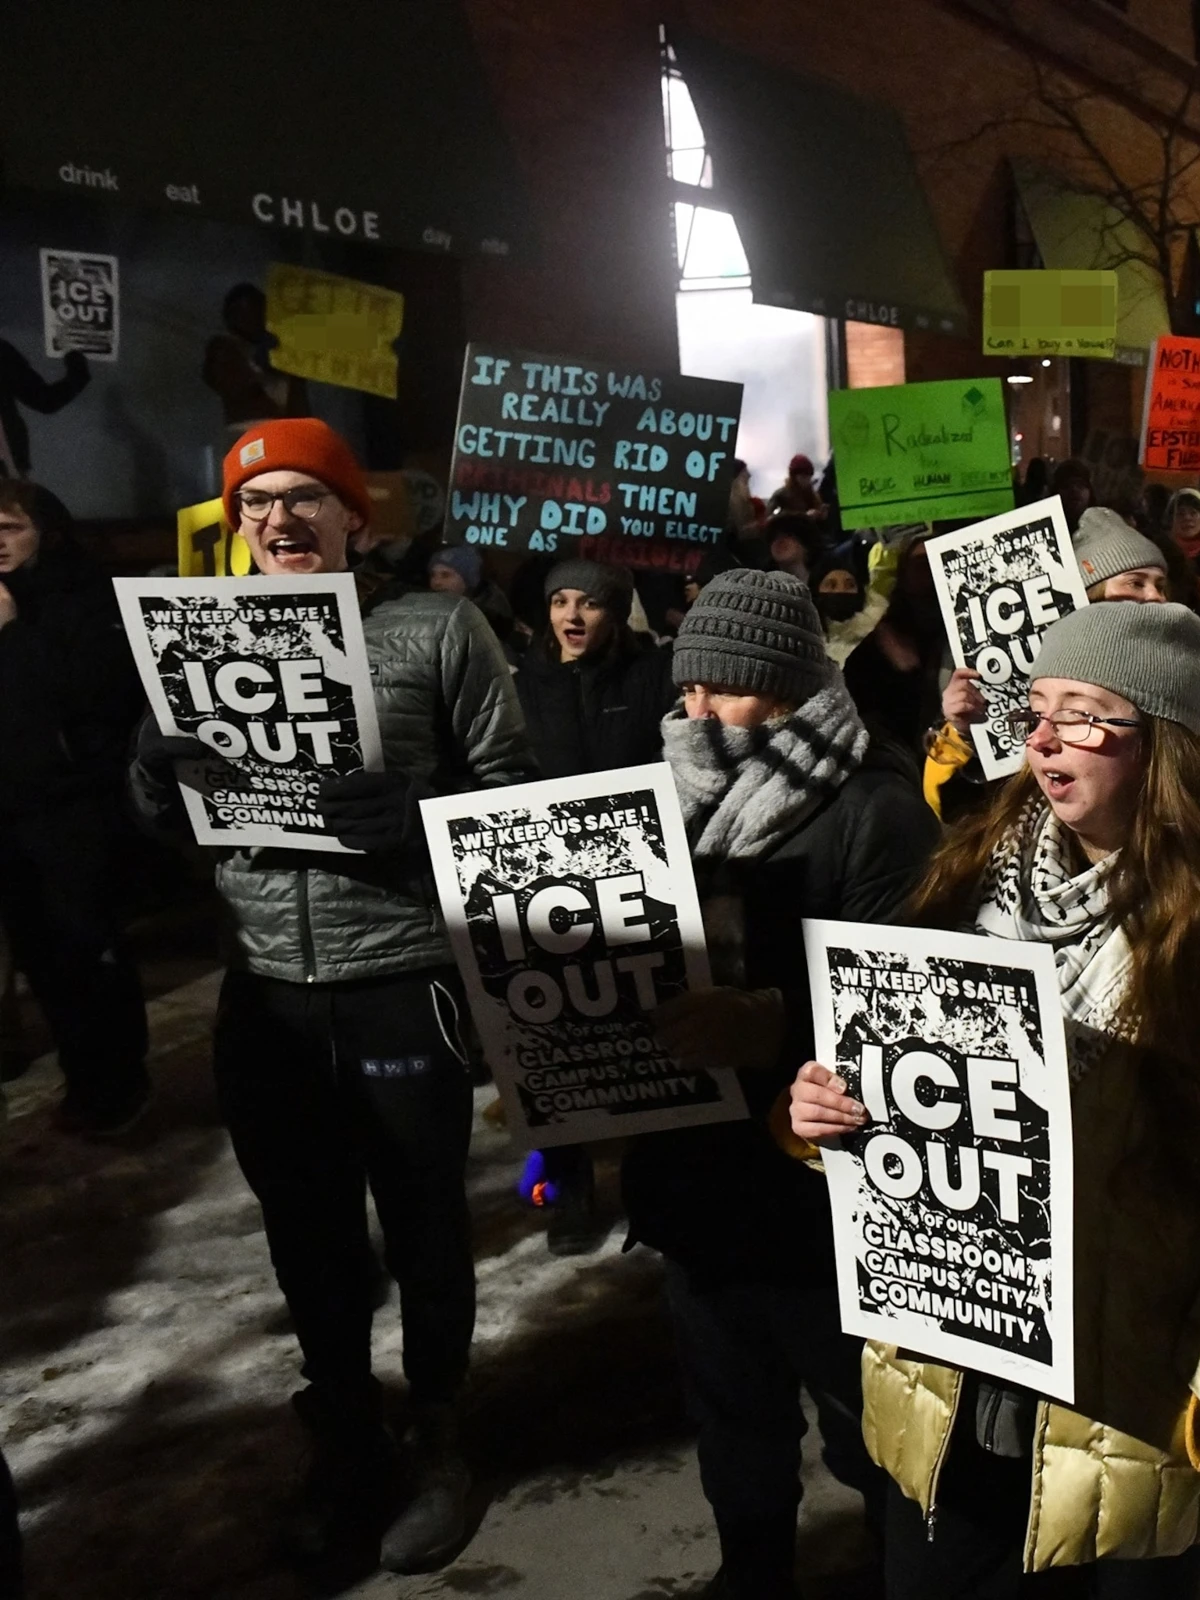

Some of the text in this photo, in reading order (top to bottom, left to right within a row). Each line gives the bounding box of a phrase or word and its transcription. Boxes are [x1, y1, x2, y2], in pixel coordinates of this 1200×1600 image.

[59, 162, 120, 192] drink
[165, 183, 200, 204] eat
[252, 192, 380, 239] CHLOE
[58, 281, 107, 304] ICE
[59, 304, 107, 322] OUT
[845, 299, 899, 325] CHLOE
[471, 356, 662, 401] IF THIS WAS
[502, 392, 737, 443] REALLY ABOUT
[457, 424, 726, 482] GETTING RID OF
[452, 490, 527, 527] WHY
[540, 499, 607, 535] DID
[620, 516, 655, 537] YOU
[665, 520, 722, 545] ELECT
[617, 483, 697, 519] THEN
[465, 525, 508, 546] ONE
[528, 529, 558, 552] AS
[948, 556, 967, 572] WE
[967, 545, 996, 566] KEEP
[995, 541, 1013, 557] US
[150, 611, 184, 624] WE
[186, 609, 236, 624] KEEP
[239, 608, 267, 623] US
[968, 574, 1061, 644] ICE
[976, 637, 1043, 685] OU
[183, 658, 329, 714] ICE
[197, 720, 341, 765] OUT
[216, 807, 326, 829] COMMUN
[459, 829, 496, 851] WE
[499, 821, 551, 846] KEEP
[552, 816, 583, 837] US
[492, 873, 653, 961] ICE
[506, 952, 664, 1025] OUT
[837, 966, 873, 988] WE
[875, 970, 928, 993] KEEP
[929, 974, 959, 997] US
[520, 1036, 668, 1068] CLASSROO
[534, 1075, 697, 1113] COMMUNITY
[860, 1043, 1022, 1143] ICE
[864, 1133, 1032, 1224] OUT
[924, 1212, 978, 1235] OF OUR
[869, 1278, 1035, 1344] COMMUNITY
